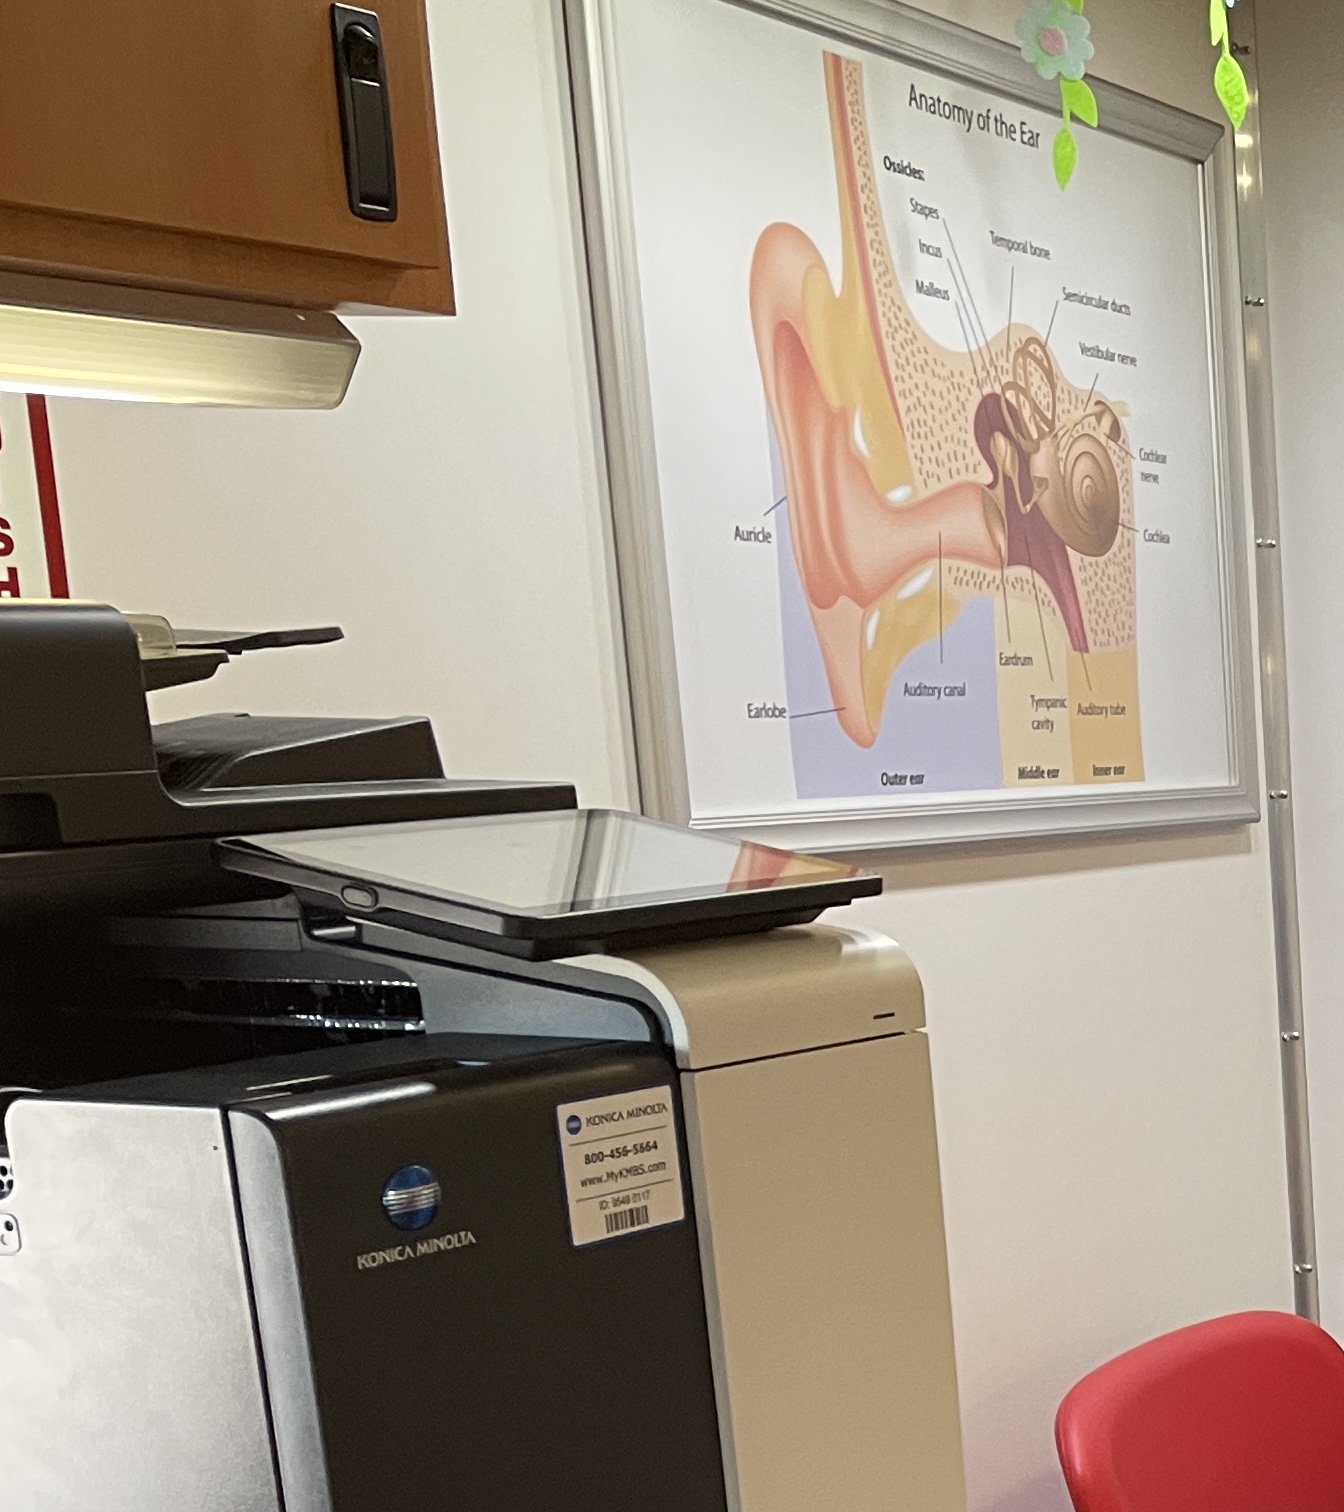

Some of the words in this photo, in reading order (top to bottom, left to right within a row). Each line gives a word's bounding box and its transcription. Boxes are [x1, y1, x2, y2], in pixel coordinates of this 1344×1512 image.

[908, 83, 974, 133] Anatomy
[976, 108, 992, 134] of
[994, 113, 1017, 142] the
[1020, 121, 1040, 149] Ear
[918, 238, 943, 259] Incus
[989, 230, 1028, 256] Temporal
[1030, 243, 1052, 261] bone
[915, 279, 951, 302] Malleus
[733, 525, 773, 545] Auricle
[903, 681, 941, 700] Auditory
[943, 681, 966, 698] canal
[747, 702, 788, 721] Earlobe
[1029, 694, 1067, 713] Tympanic
[1031, 716, 1055, 733] cavity
[880, 772, 906, 787] Outer
[585, 1111, 625, 1128] KONICA
[626, 1102, 669, 1119] MINOLTA
[356, 1244, 415, 1270] KONICA
[416, 1230, 477, 1257] MINOLTA
